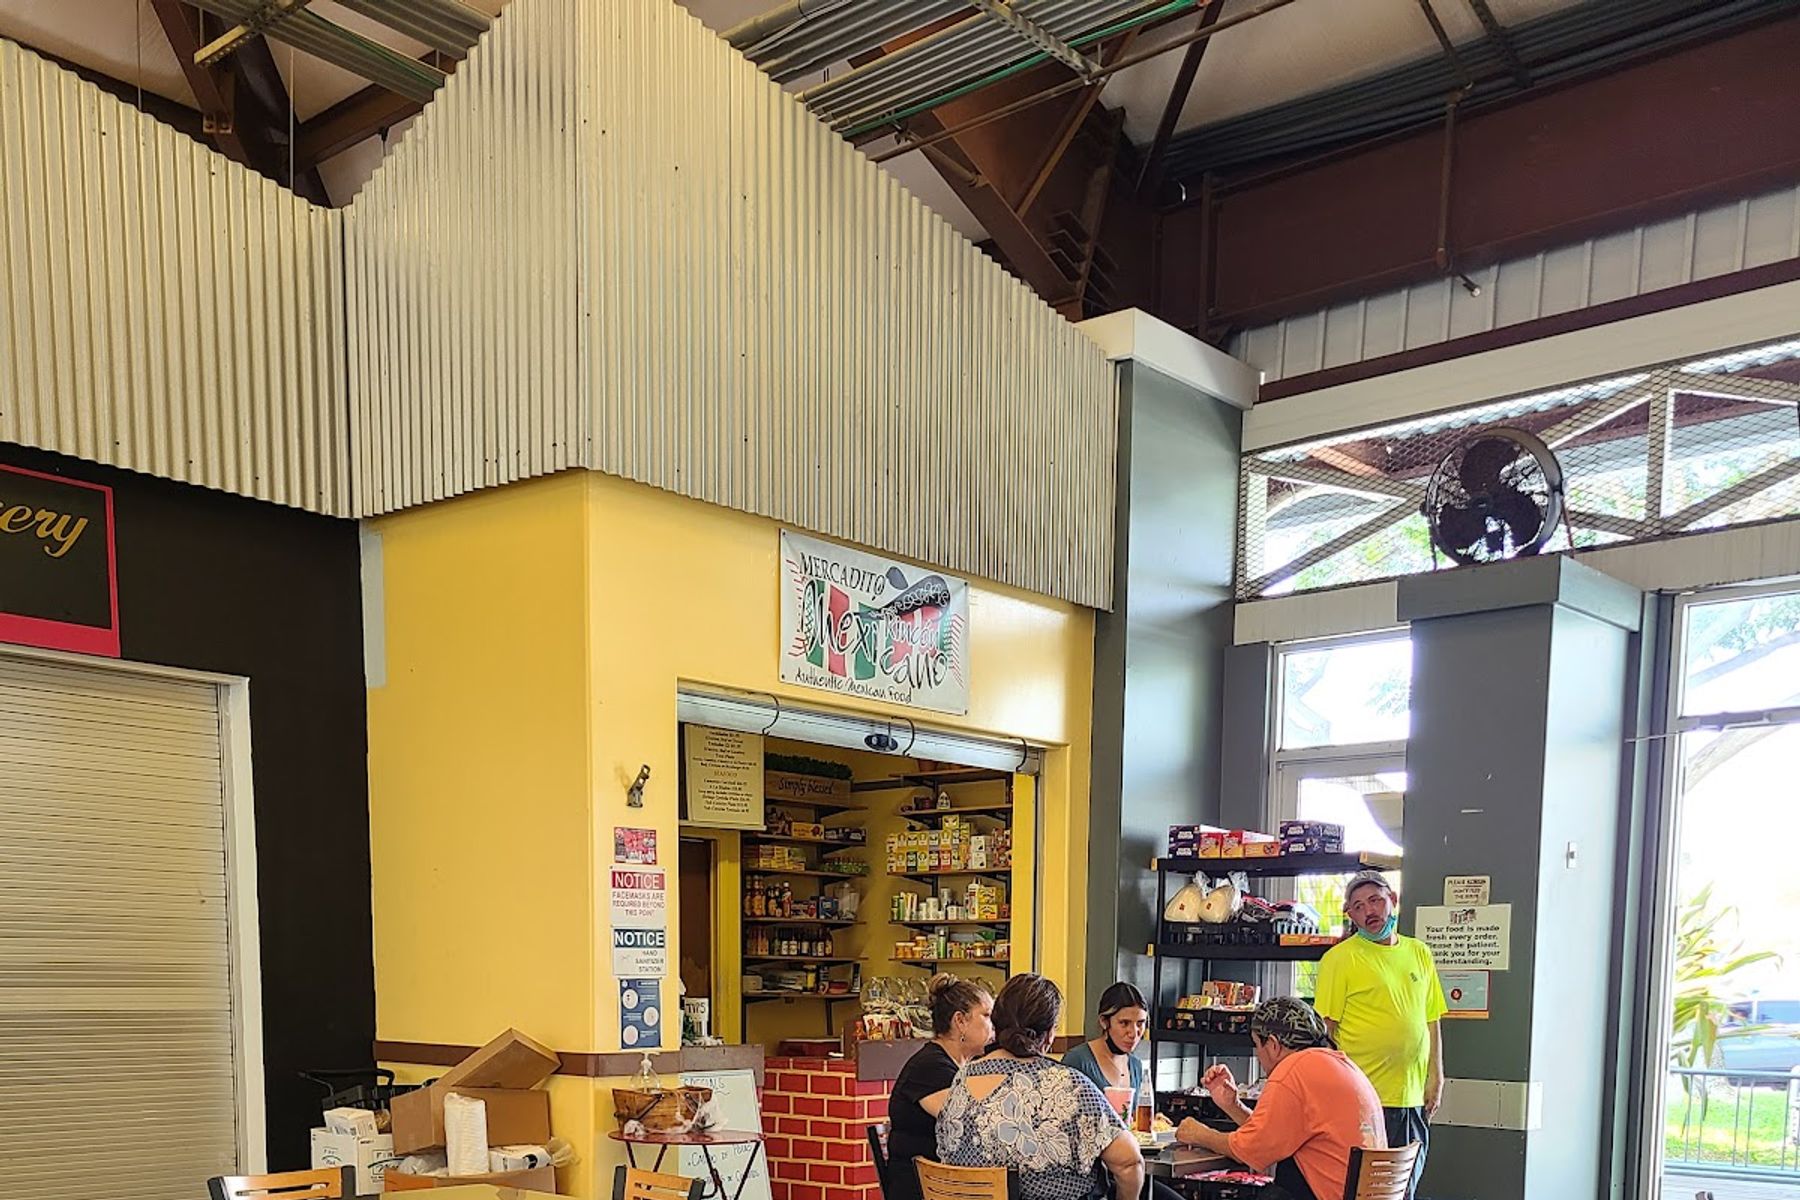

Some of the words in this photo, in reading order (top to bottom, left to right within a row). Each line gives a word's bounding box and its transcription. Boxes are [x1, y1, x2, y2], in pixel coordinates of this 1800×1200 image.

[0, 504, 89, 558] ery
[800, 552, 886, 596] MERCADITO
[795, 667, 844, 691] Authentic
[889, 685, 912, 704] Food
[615, 872, 660, 889] NOTICE
[612, 891, 651, 899] FACEMASKS
[652, 892, 664, 900] ARE
[612, 900, 641, 908] REQUIRED
[642, 901, 665, 909] BEYOND
[639, 909, 656, 917] POINT
[1425, 925, 1444, 933] Your
[1446, 925, 1464, 933] food
[615, 931, 664, 946] NOTICE
[1468, 949, 1480, 957] for
[1435, 958, 1493, 966] nderstanding.
